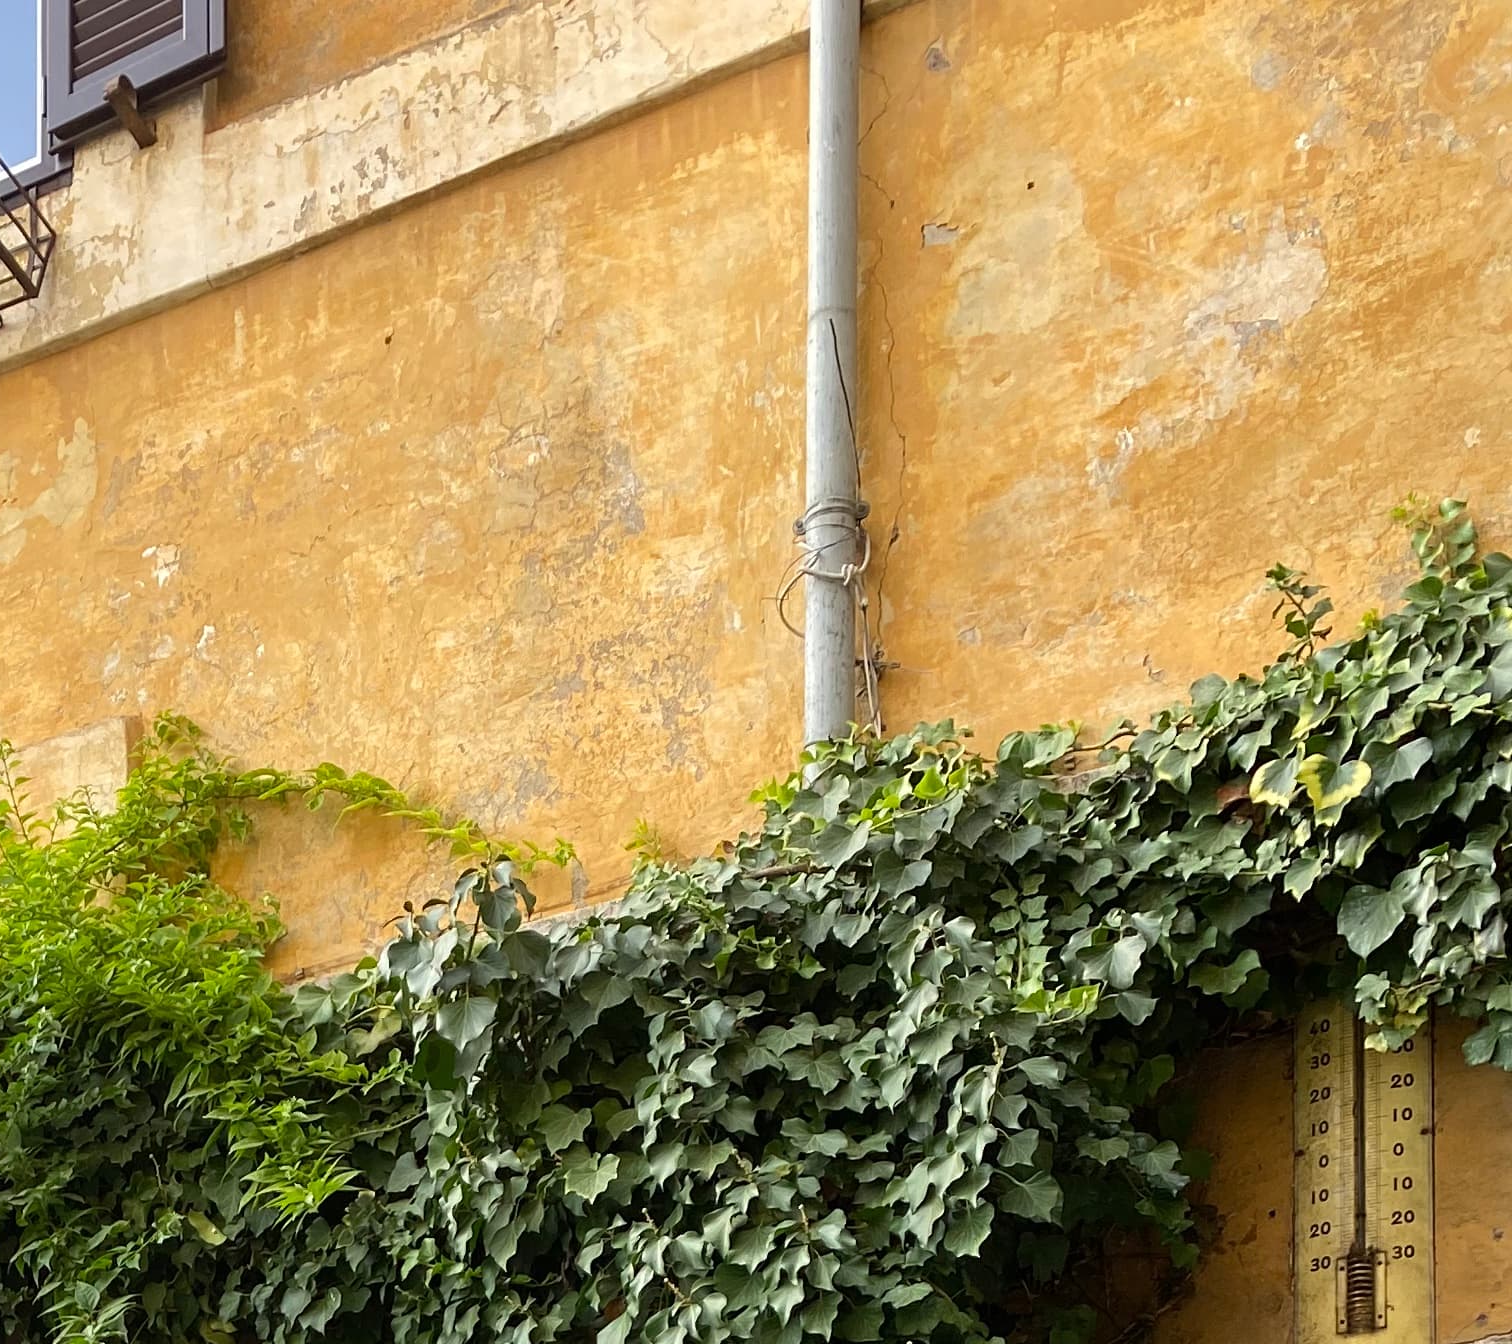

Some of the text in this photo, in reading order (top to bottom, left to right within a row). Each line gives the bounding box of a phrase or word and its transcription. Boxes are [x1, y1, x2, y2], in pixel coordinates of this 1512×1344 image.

[1309, 1019, 1330, 1035] 40
[1310, 1053, 1330, 1070] 30
[1390, 1073, 1414, 1088] 20
[1309, 1087, 1330, 1104] 20
[1393, 1107, 1413, 1122] 10
[1311, 1120, 1329, 1136] 10
[1393, 1142, 1404, 1156] 0
[1318, 1154, 1329, 1168] 0
[1393, 1176, 1413, 1191] 10
[1311, 1189, 1329, 1205] 10
[1391, 1210, 1415, 1225] 20
[1309, 1221, 1331, 1239] 20
[1392, 1244, 1415, 1259] 30
[1310, 1256, 1331, 1272] 30
